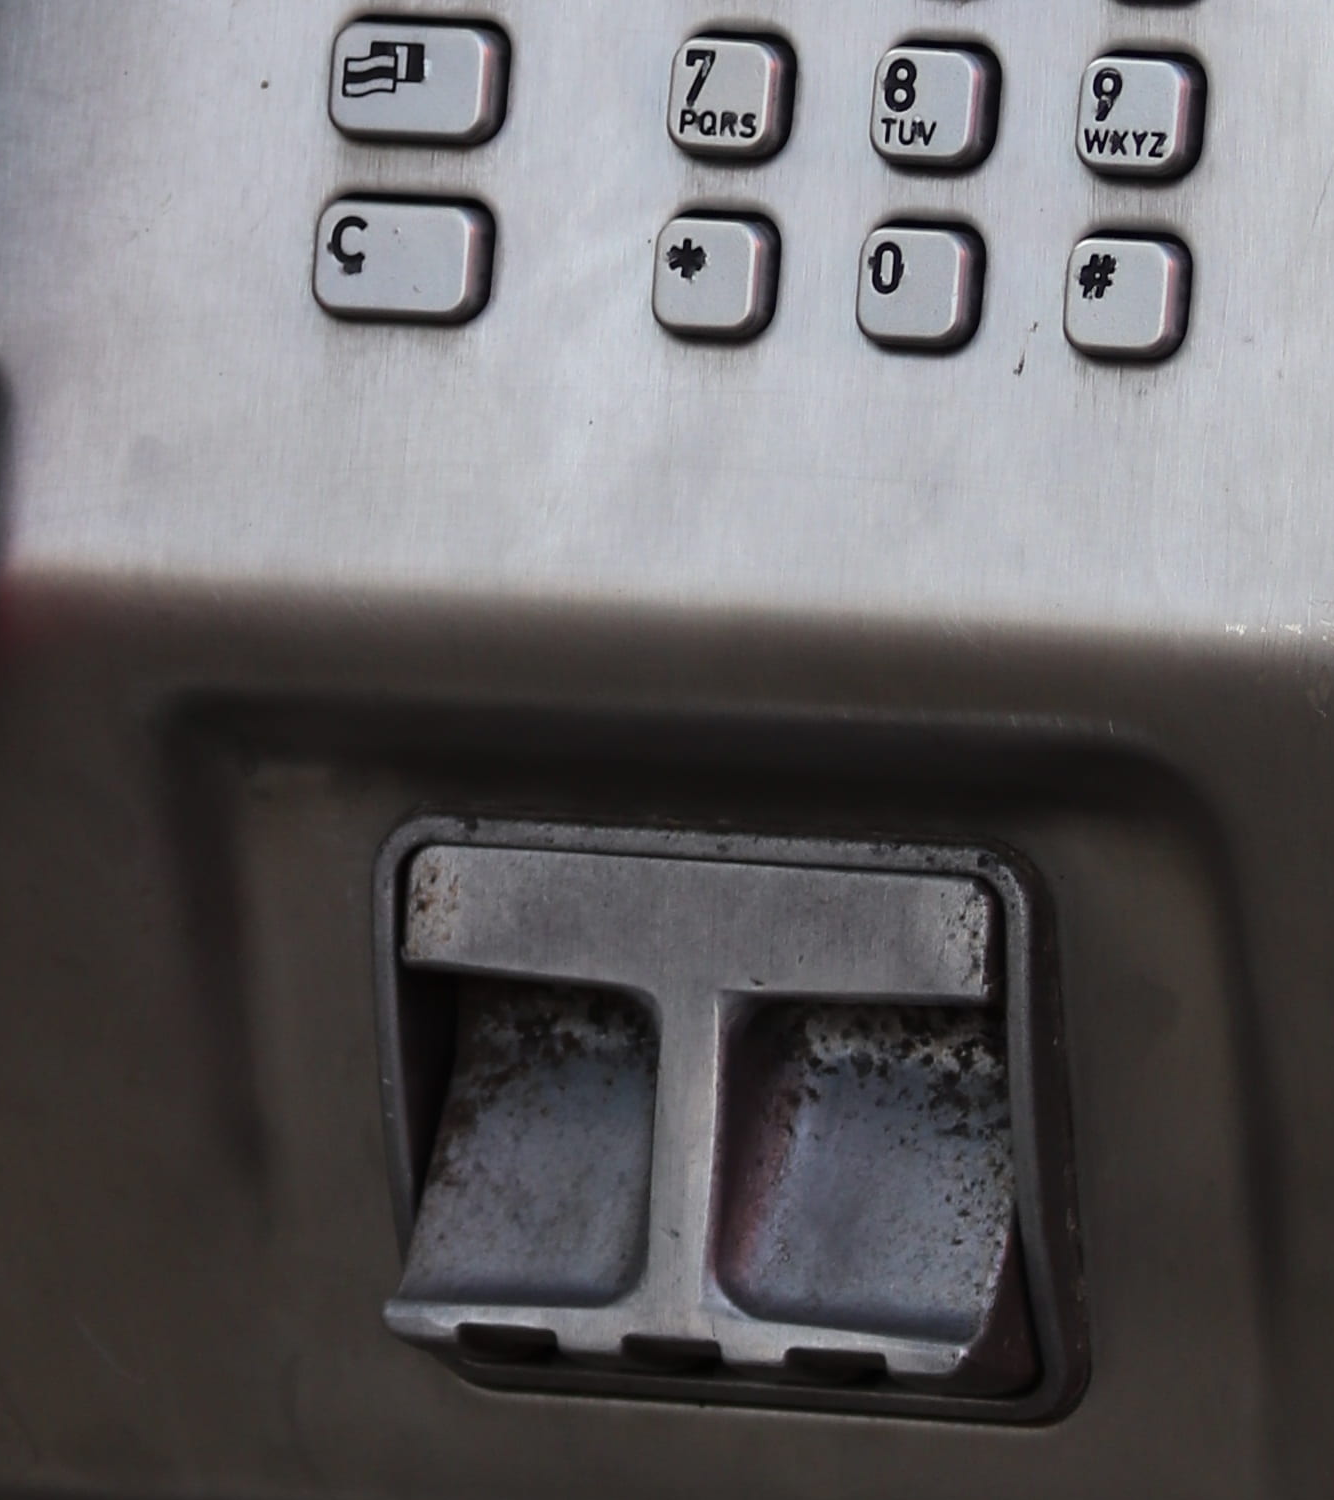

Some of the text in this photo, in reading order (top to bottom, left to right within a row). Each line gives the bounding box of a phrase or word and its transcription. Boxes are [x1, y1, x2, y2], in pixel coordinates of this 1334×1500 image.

[684, 47, 718, 107] 7
[882, 56, 919, 114] 8
[1091, 66, 1124, 123] 9
[677, 106, 759, 141] PQRS
[878, 116, 939, 148] TUV
[1081, 126, 1169, 160] WXYZ
